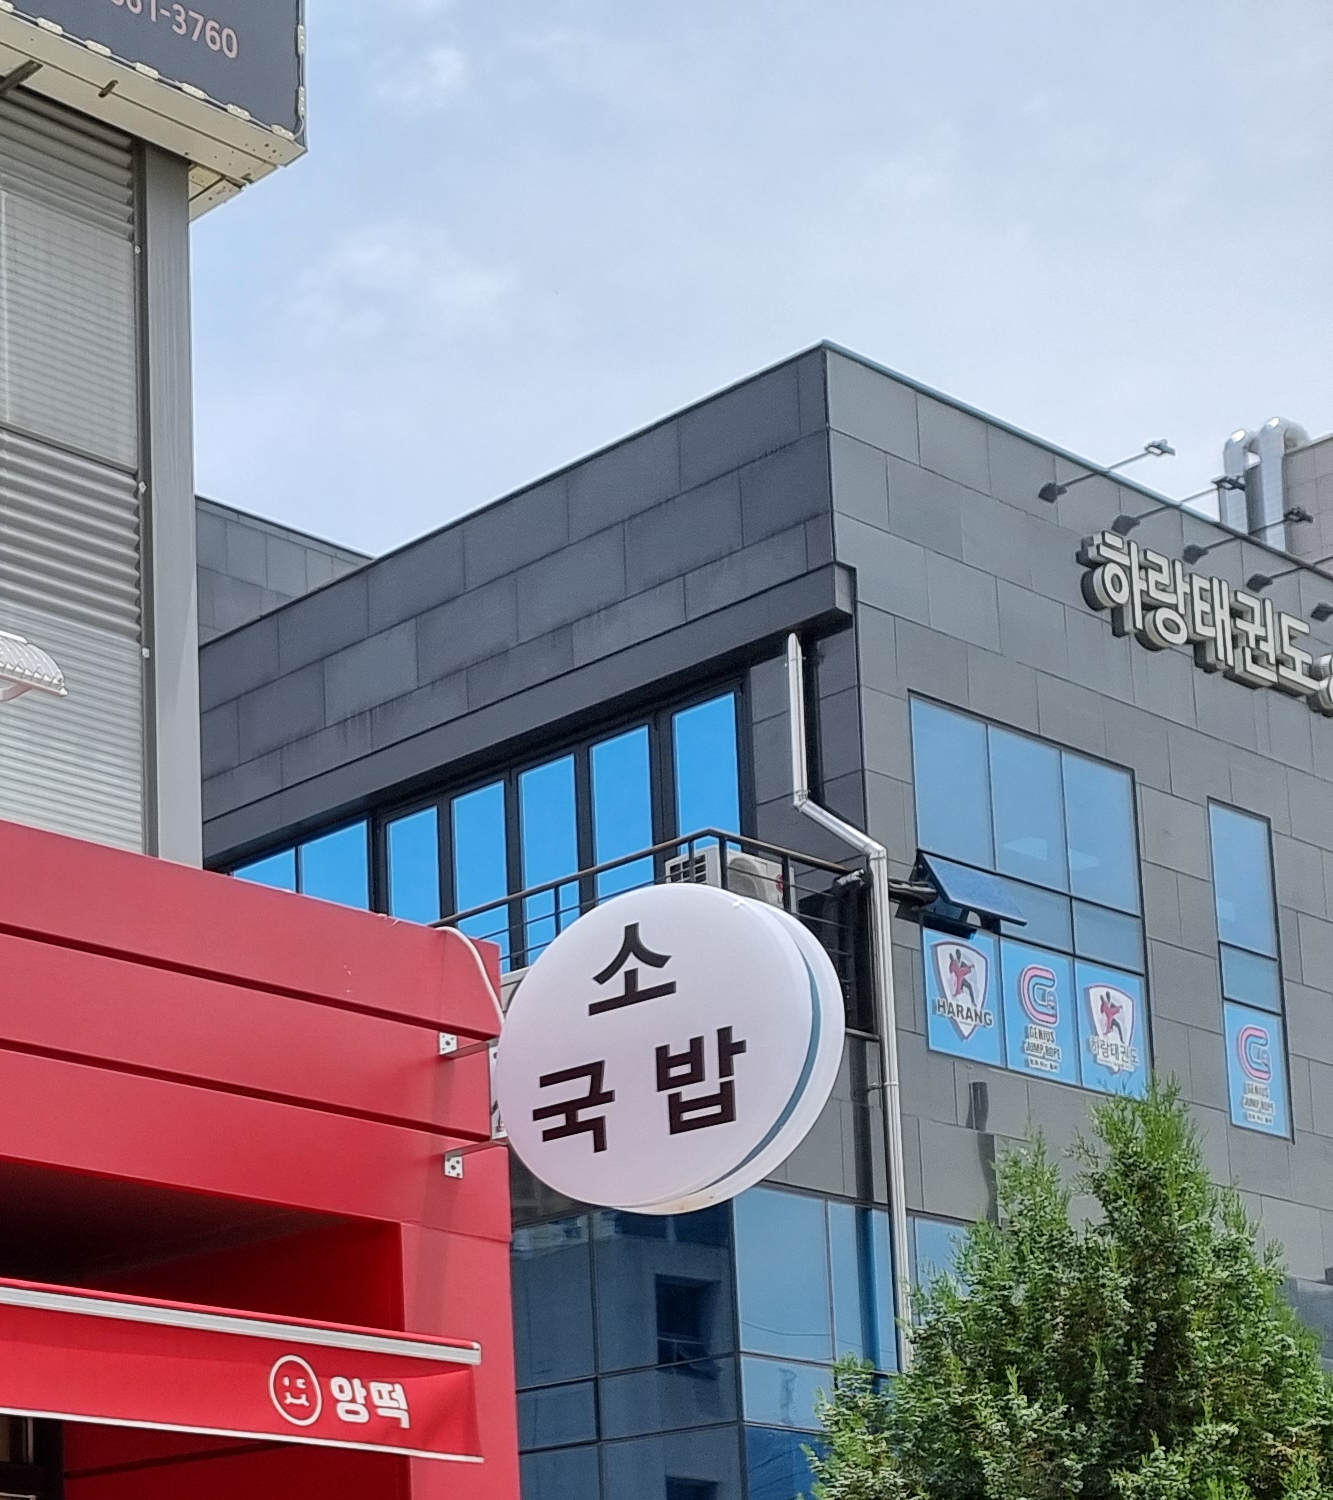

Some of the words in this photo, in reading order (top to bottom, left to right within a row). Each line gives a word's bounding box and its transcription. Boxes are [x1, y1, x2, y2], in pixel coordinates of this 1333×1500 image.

[589, 922, 676, 1016] 소
[936, 998, 993, 1027] HARANG
[1030, 1027, 1055, 1043] GENIUS
[1090, 1037, 1140, 1063] 하랑태권도
[533, 1025, 747, 1153] 국밥
[330, 1376, 410, 1429] 앙떡
